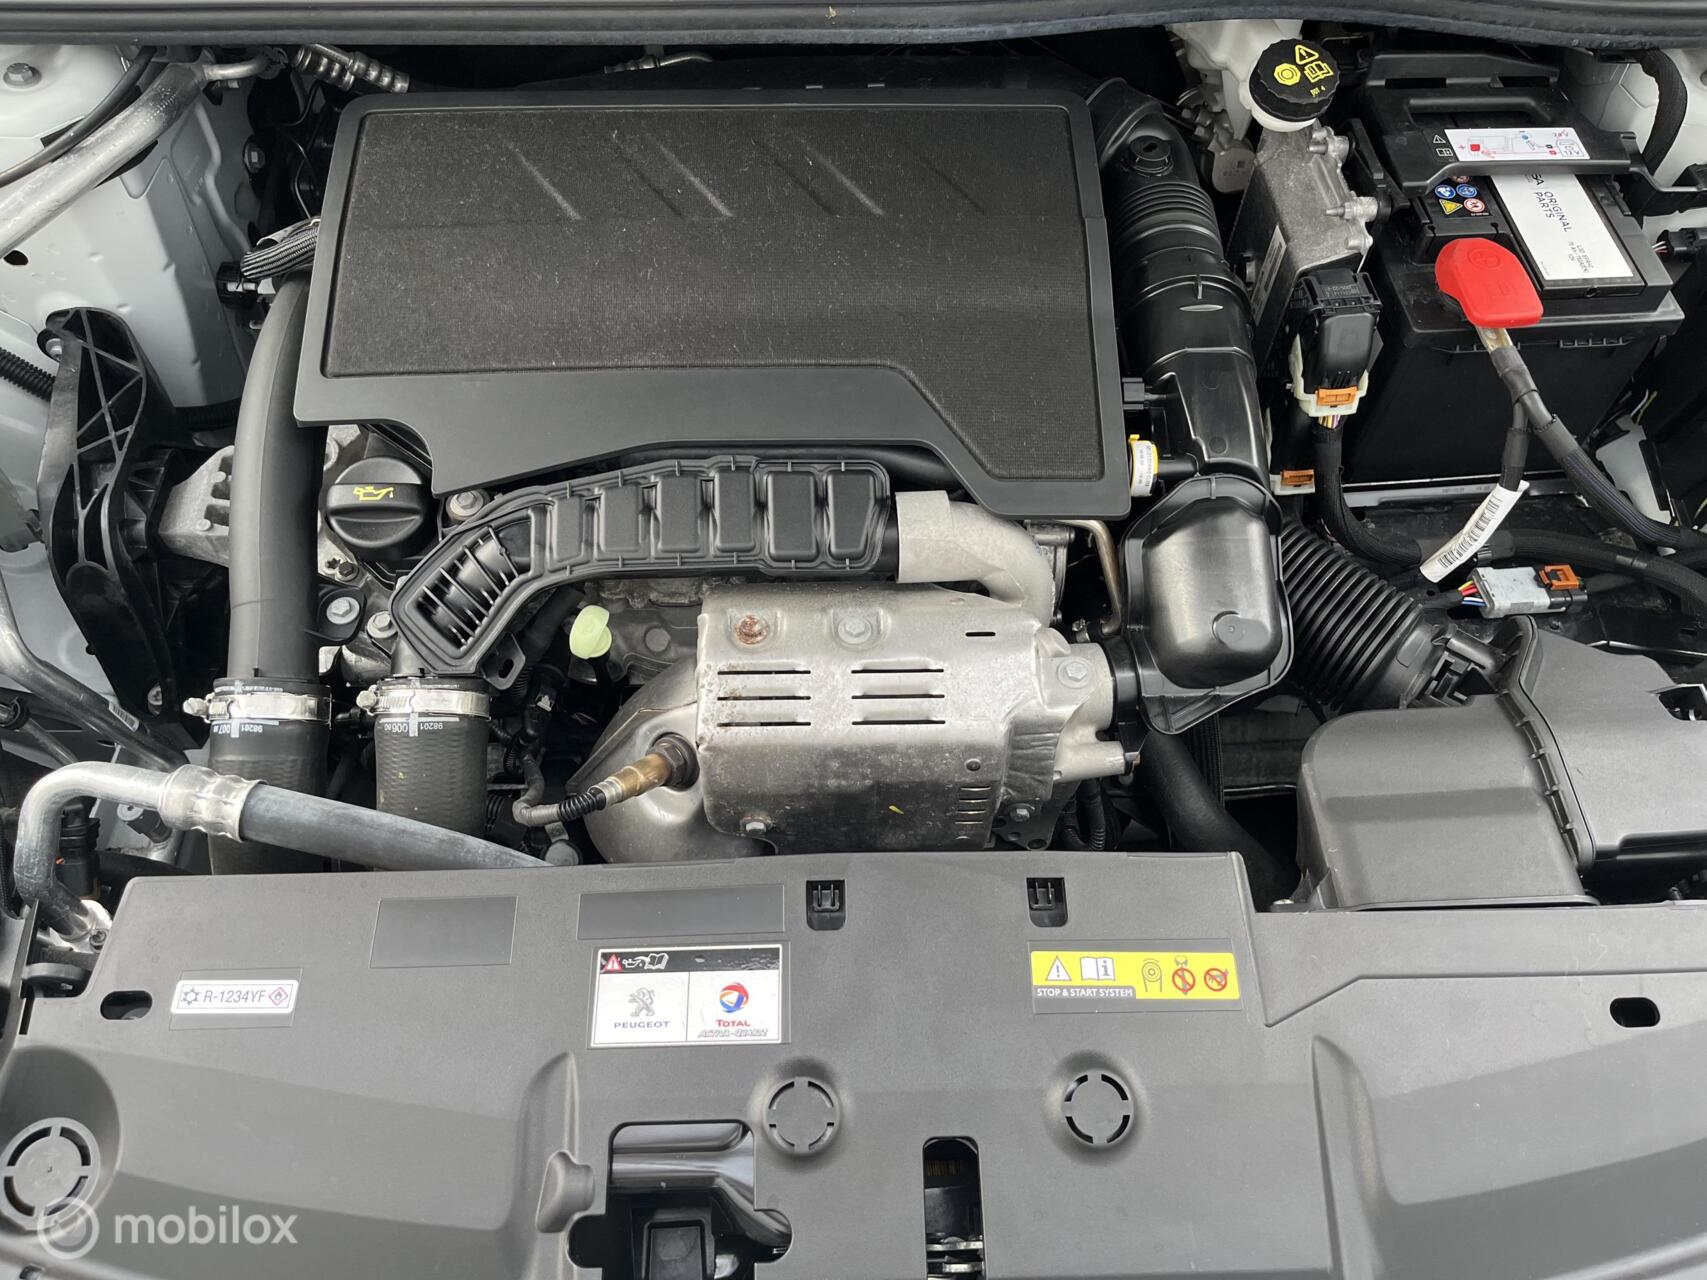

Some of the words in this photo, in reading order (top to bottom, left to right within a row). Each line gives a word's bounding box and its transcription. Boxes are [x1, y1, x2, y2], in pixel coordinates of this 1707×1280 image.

[1531, 173, 1545, 186] SA
[1535, 192, 1555, 218] PARTS
[1544, 191, 1572, 232] ORIGINAL
[203, 990, 267, 1003] R-1234YF
[1037, 988, 1061, 997] STOP
[1062, 988, 1069, 997] &
[1070, 988, 1098, 997] START
[1099, 988, 1133, 997] SYSTEM
[613, 1020, 671, 1029] PEUGEOT
[715, 1018, 752, 1028] TOTAL
